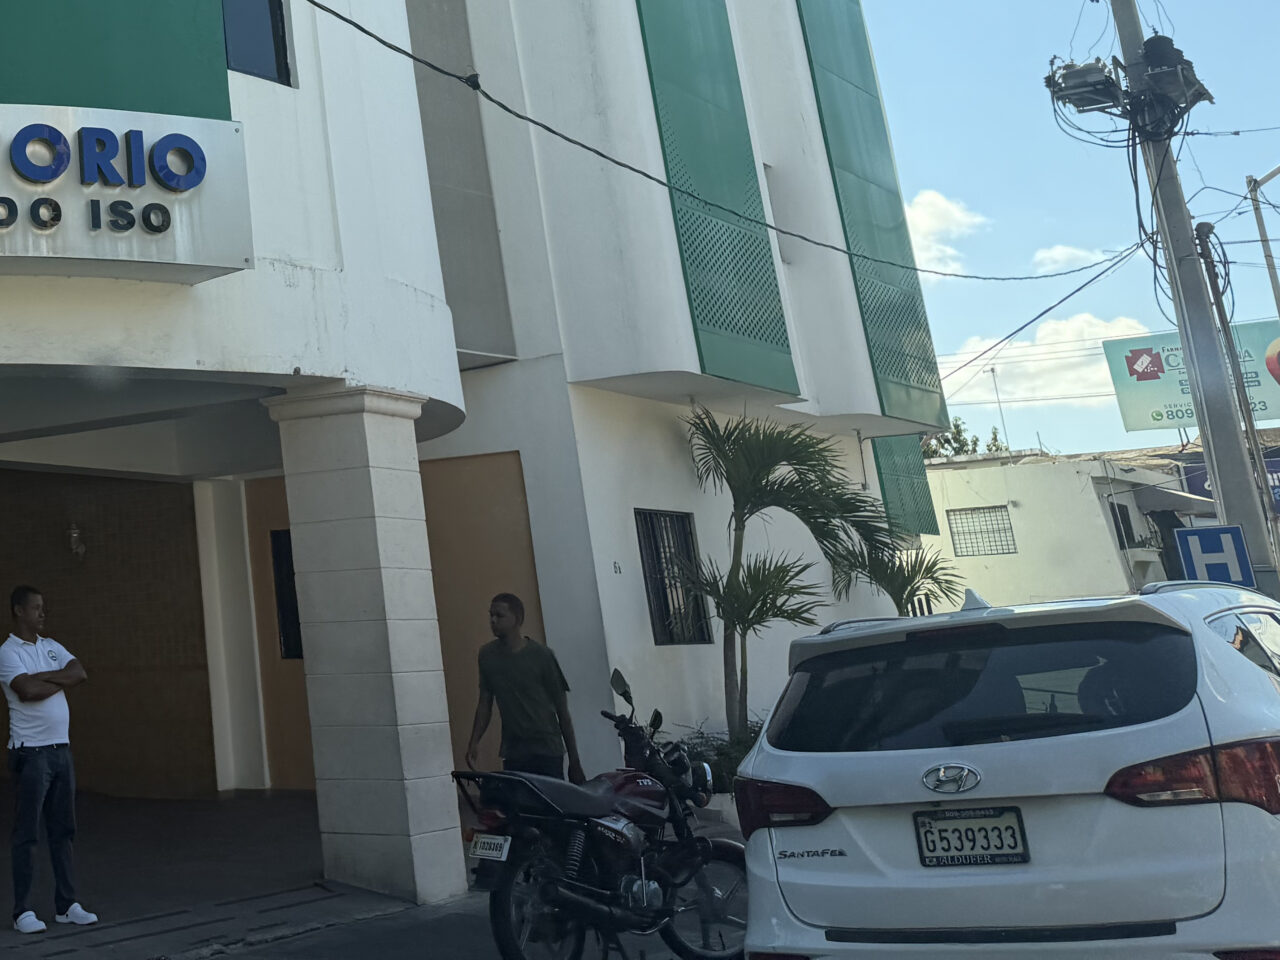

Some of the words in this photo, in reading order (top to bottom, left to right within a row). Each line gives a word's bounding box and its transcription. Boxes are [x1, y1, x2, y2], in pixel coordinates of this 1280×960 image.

[90, 198, 172, 235] ISO
[1187, 533, 1243, 581] H
[924, 825, 1018, 853] G539333
